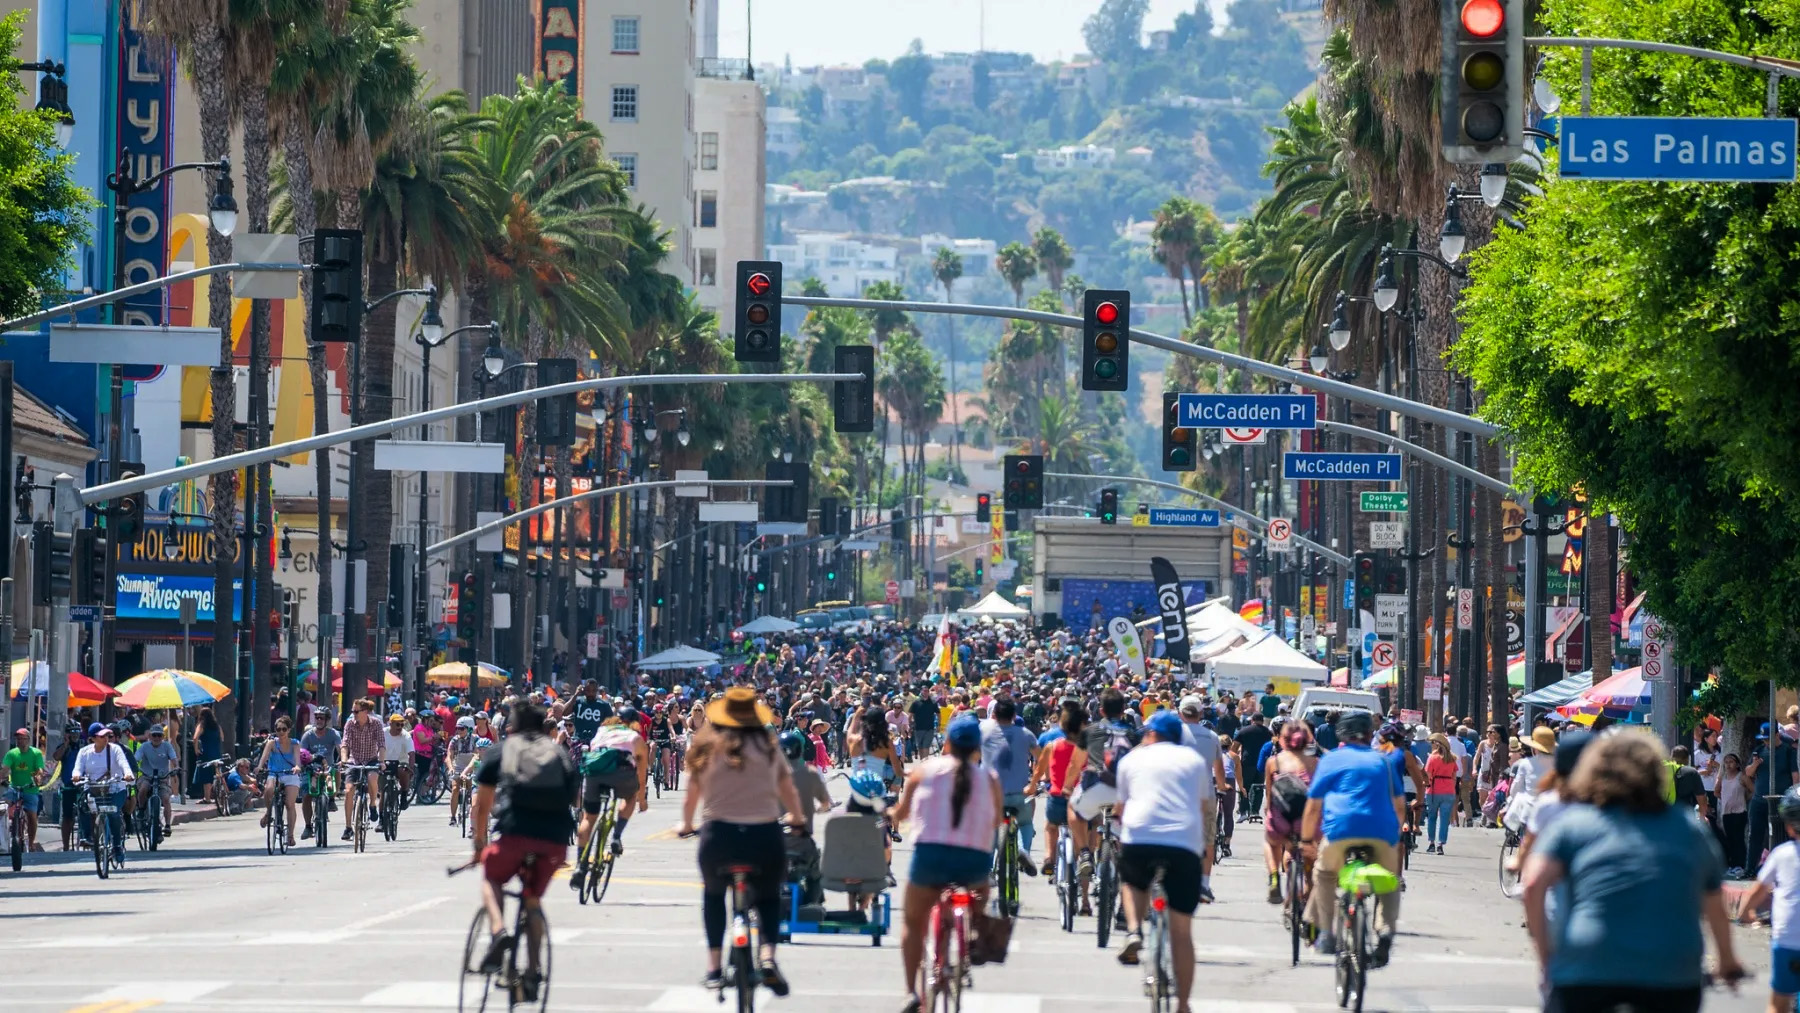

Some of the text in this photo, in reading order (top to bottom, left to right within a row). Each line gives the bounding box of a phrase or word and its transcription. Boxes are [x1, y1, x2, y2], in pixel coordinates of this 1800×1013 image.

[1568, 132, 1787, 165] Las Palmas
[1188, 402, 1306, 420] McCadden Pl
[1295, 459, 1390, 474] McCadden Pl
[1368, 494, 1393, 503] Dolby
[1364, 502, 1398, 510] Theatre
[1155, 512, 1213, 524] Highland Av
[1374, 524, 1398, 532] DO NOT
[1375, 532, 1397, 540] BLOCK
[138, 586, 217, 612] Awesome!
[1381, 610, 1408, 618] MUT
[576, 703, 601, 721] Lee
